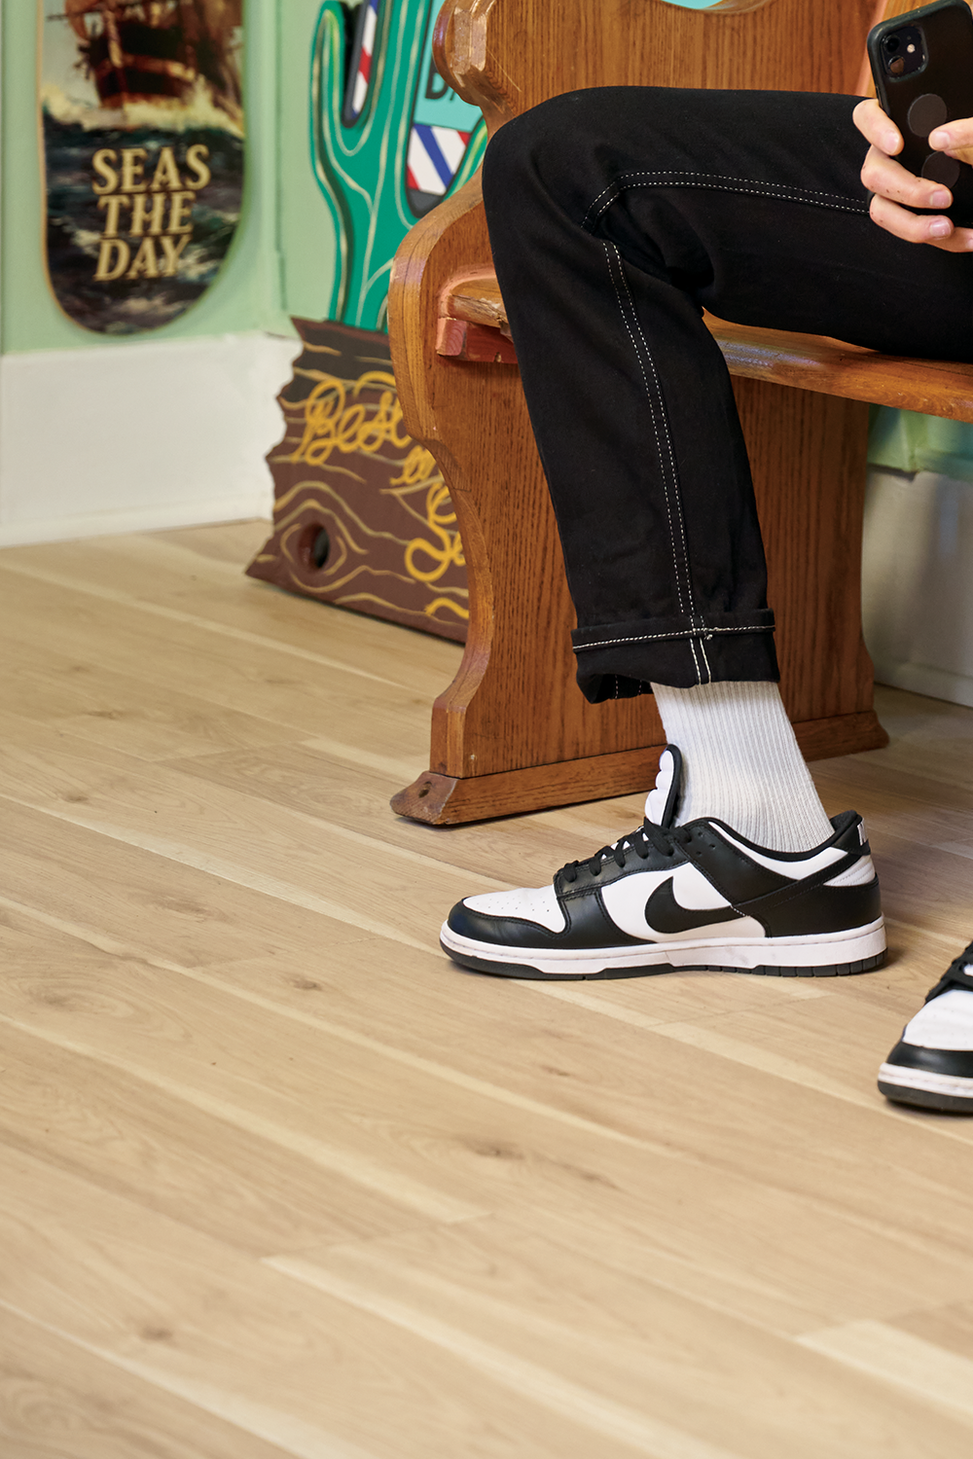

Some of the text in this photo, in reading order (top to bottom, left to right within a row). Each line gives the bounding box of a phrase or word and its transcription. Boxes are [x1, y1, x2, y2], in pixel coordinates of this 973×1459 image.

[92, 144, 211, 195] SEAS
[97, 190, 196, 238] THE
[92, 234, 193, 282] DAY
